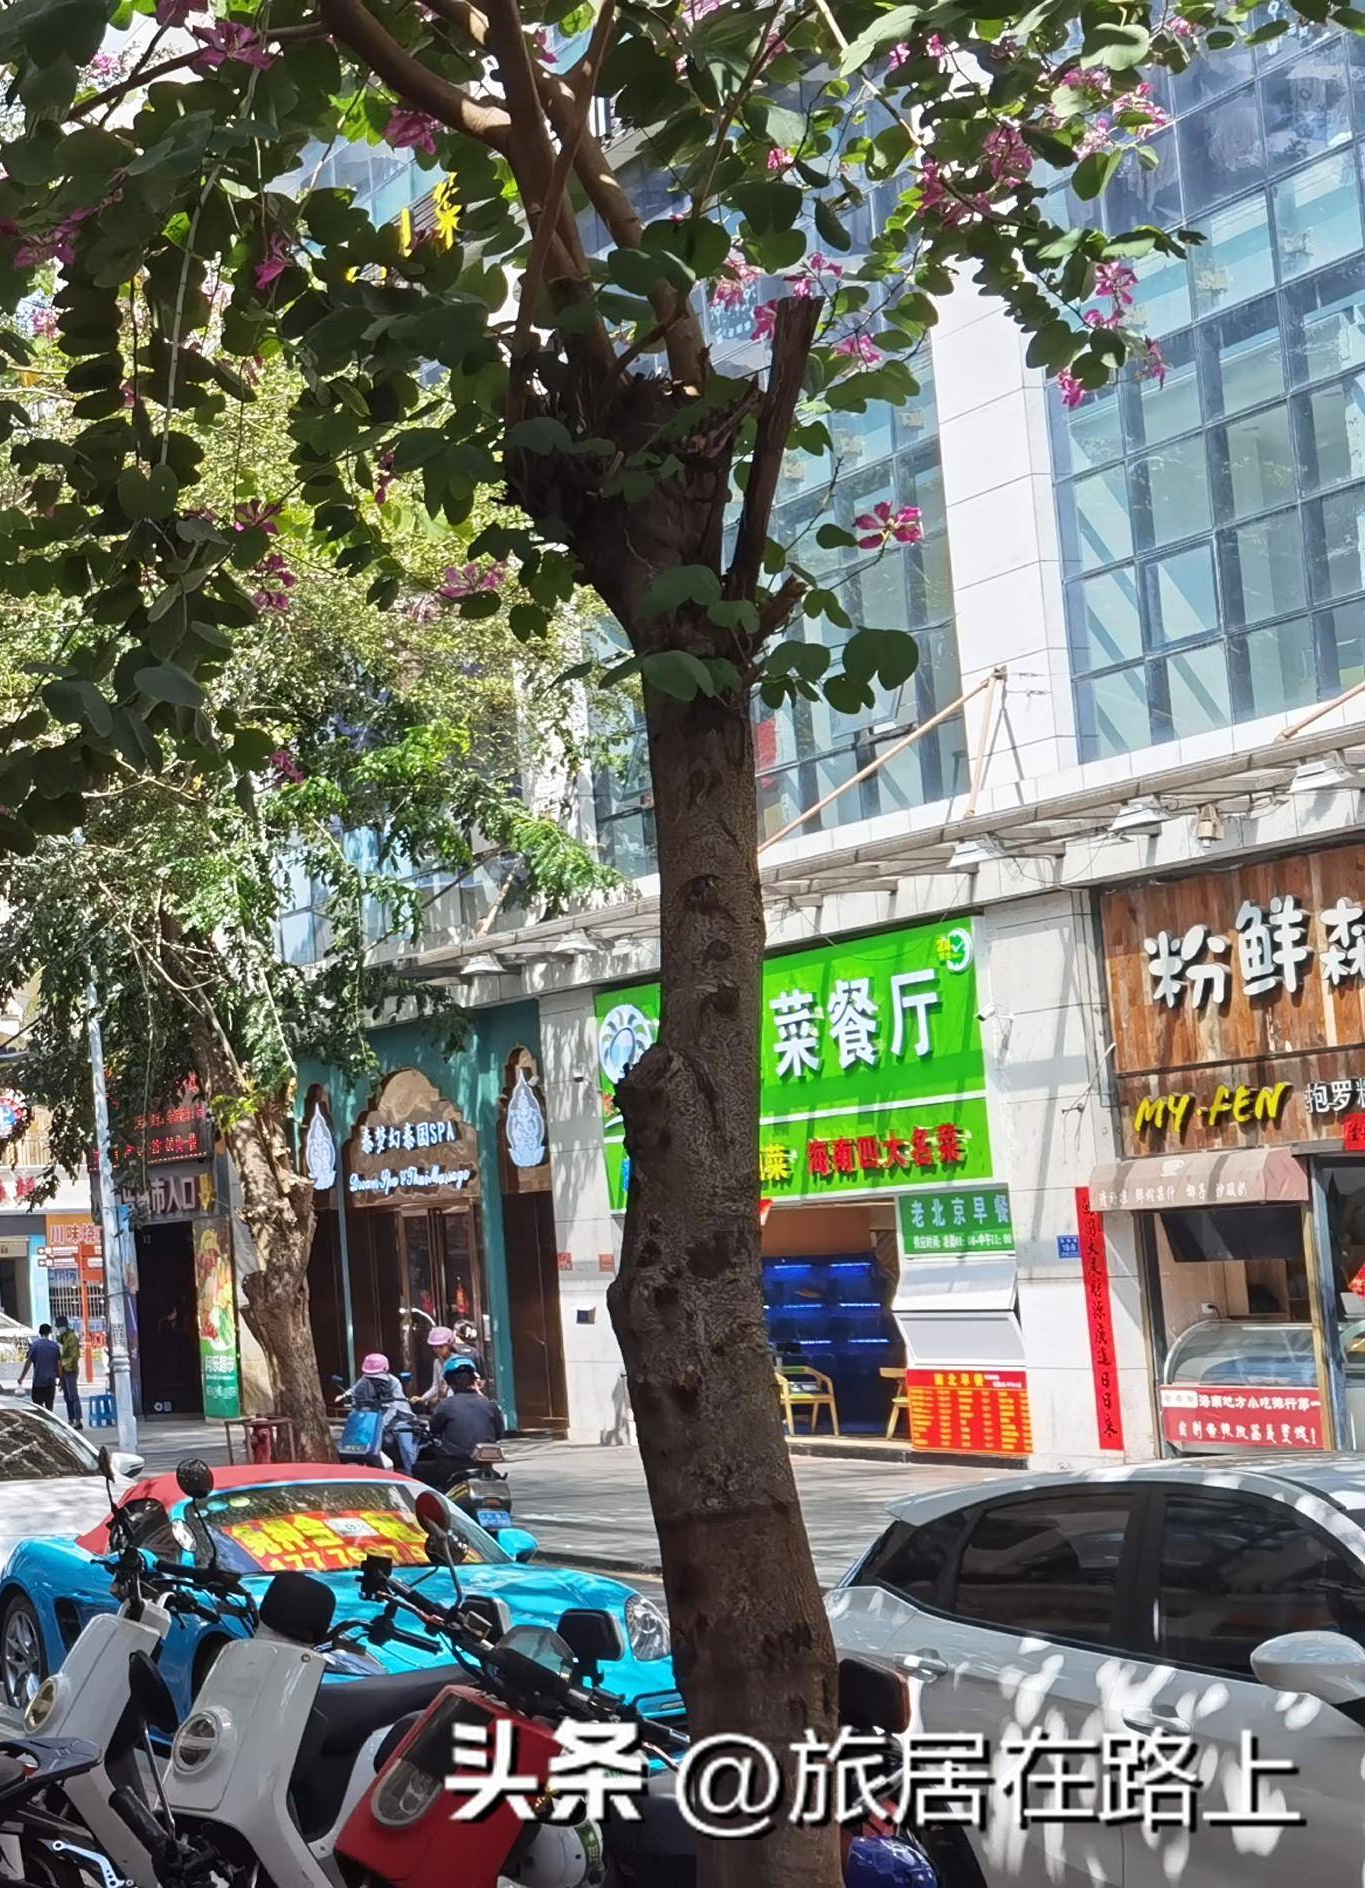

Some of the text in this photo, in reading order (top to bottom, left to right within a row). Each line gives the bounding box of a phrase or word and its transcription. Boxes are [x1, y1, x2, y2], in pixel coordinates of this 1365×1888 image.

[1143, 894, 1365, 1008] 粉鲜森
[769, 968, 939, 1077] 菜餐厅
[806, 1122, 967, 1176] 海南四大名菜
[911, 1194, 1009, 1228] 老北京早餐
